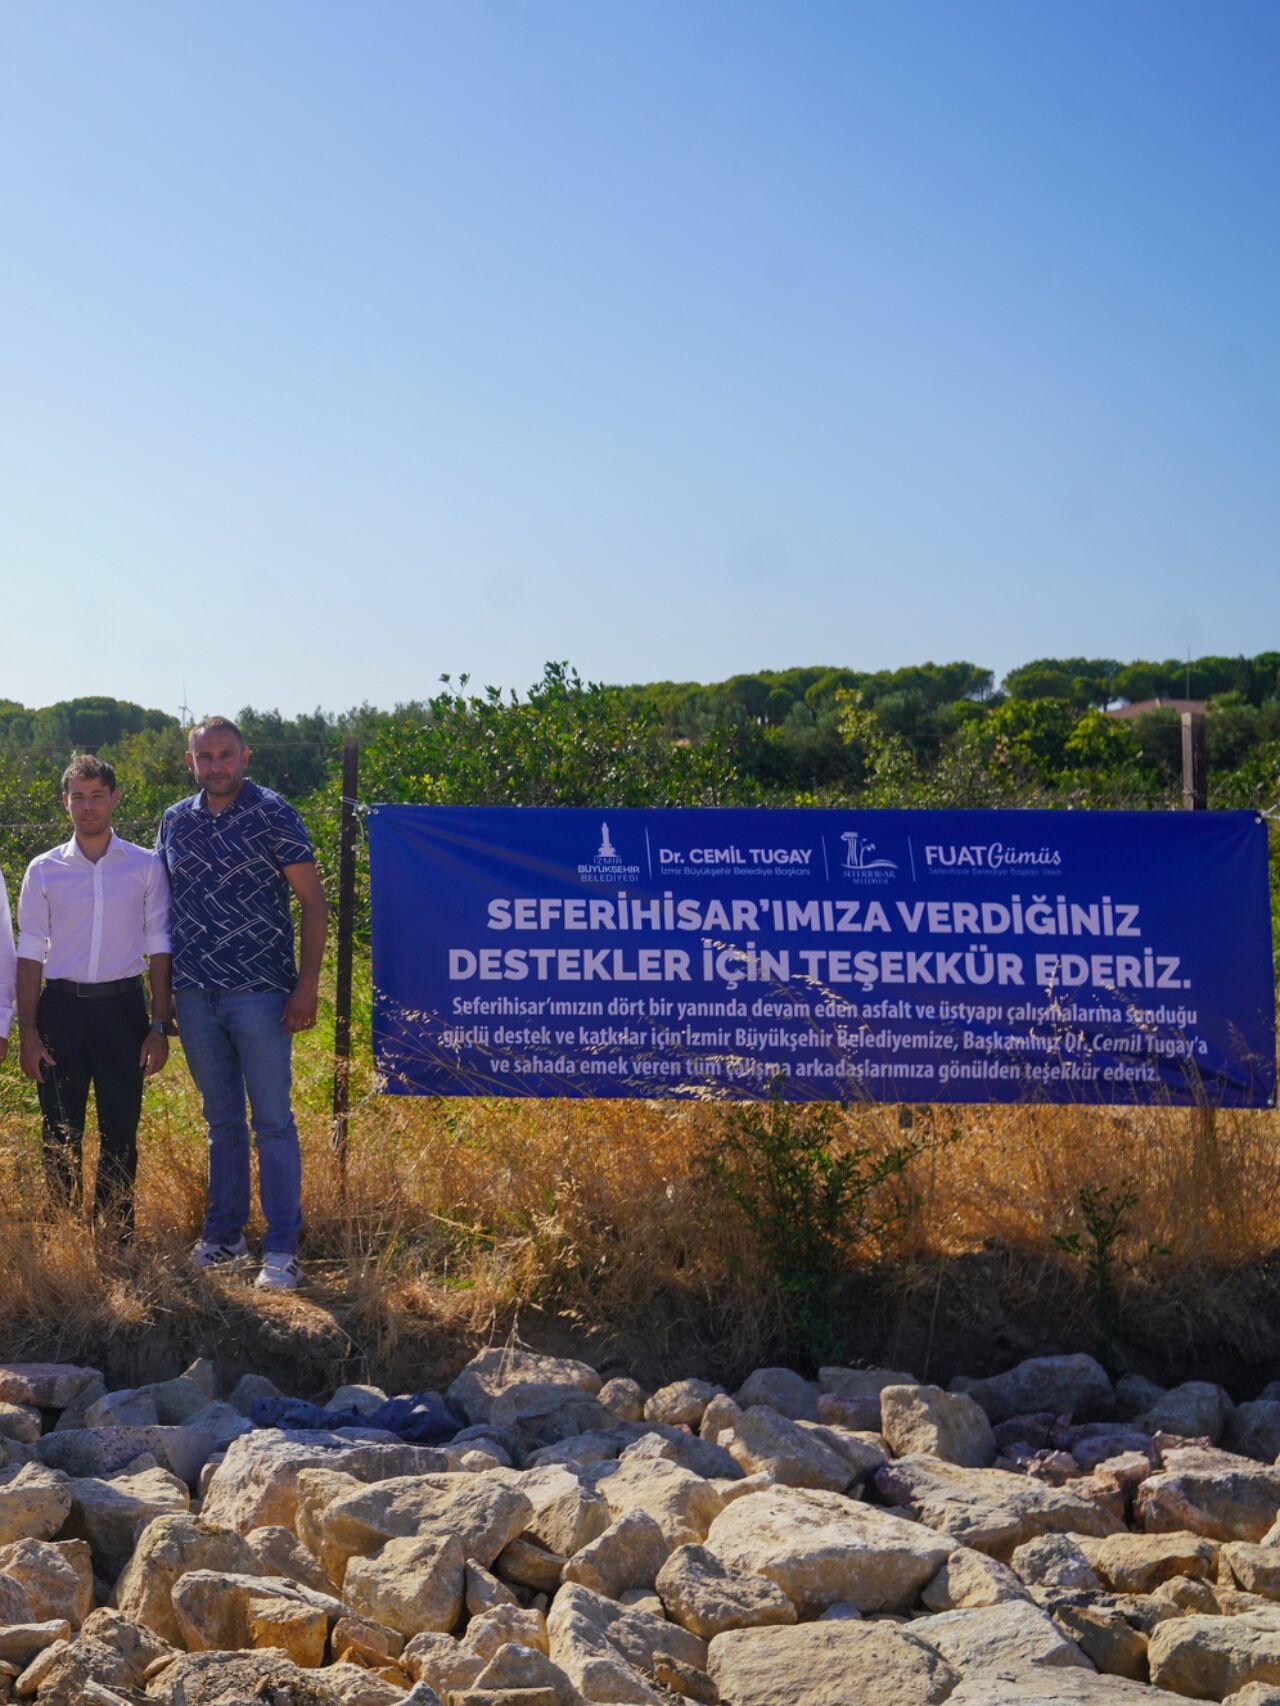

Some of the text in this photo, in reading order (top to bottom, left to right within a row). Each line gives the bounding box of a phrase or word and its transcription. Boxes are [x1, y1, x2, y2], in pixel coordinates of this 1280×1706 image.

[659, 845, 812, 864] Dr. CEMİL TUGAY
[925, 845, 987, 865] FUAT
[487, 890, 1141, 937] SEFERİHİSAR'IMIZA VERDİĞİNİZ
[449, 941, 1191, 992] DESTEKLER İÇİN TEŞEKKÜR EDERİZ.
[452, 997, 603, 1017] Seferihisar'ımızın
[607, 998, 644, 1016] dört
[649, 998, 674, 1016] bir
[677, 999, 747, 1021] yanında
[752, 999, 810, 1018] devam
[815, 1000, 858, 1018] eden
[862, 1000, 912, 1019] asfalt
[915, 1005, 936, 1019] ve
[939, 1002, 1003, 1025] üstyapı
[443, 1025, 489, 1049] güçlü
[494, 1026, 551, 1045] destek
[554, 1030, 575, 1045] ve
[651, 1027, 682, 1050] için
[686, 1024, 731, 1047] İzmir
[735, 1028, 833, 1051] Büyükşehir
[1065, 1032, 1089, 1051] Dr.
[1092, 1033, 1141, 1054] Cemil
[1144, 1035, 1208, 1059] Tugay'a
[490, 1060, 509, 1073] ve
[513, 1055, 575, 1074] sahada
[580, 1056, 628, 1075] emek
[632, 1061, 682, 1075] veren
[685, 1058, 721, 1076] tüm
[795, 1059, 934, 1082] arkadaşlarımıza
[938, 1060, 1020, 1083] gönülden
[1025, 1063, 1100, 1084] teşekkür
[1103, 1063, 1160, 1083] ederiz.
